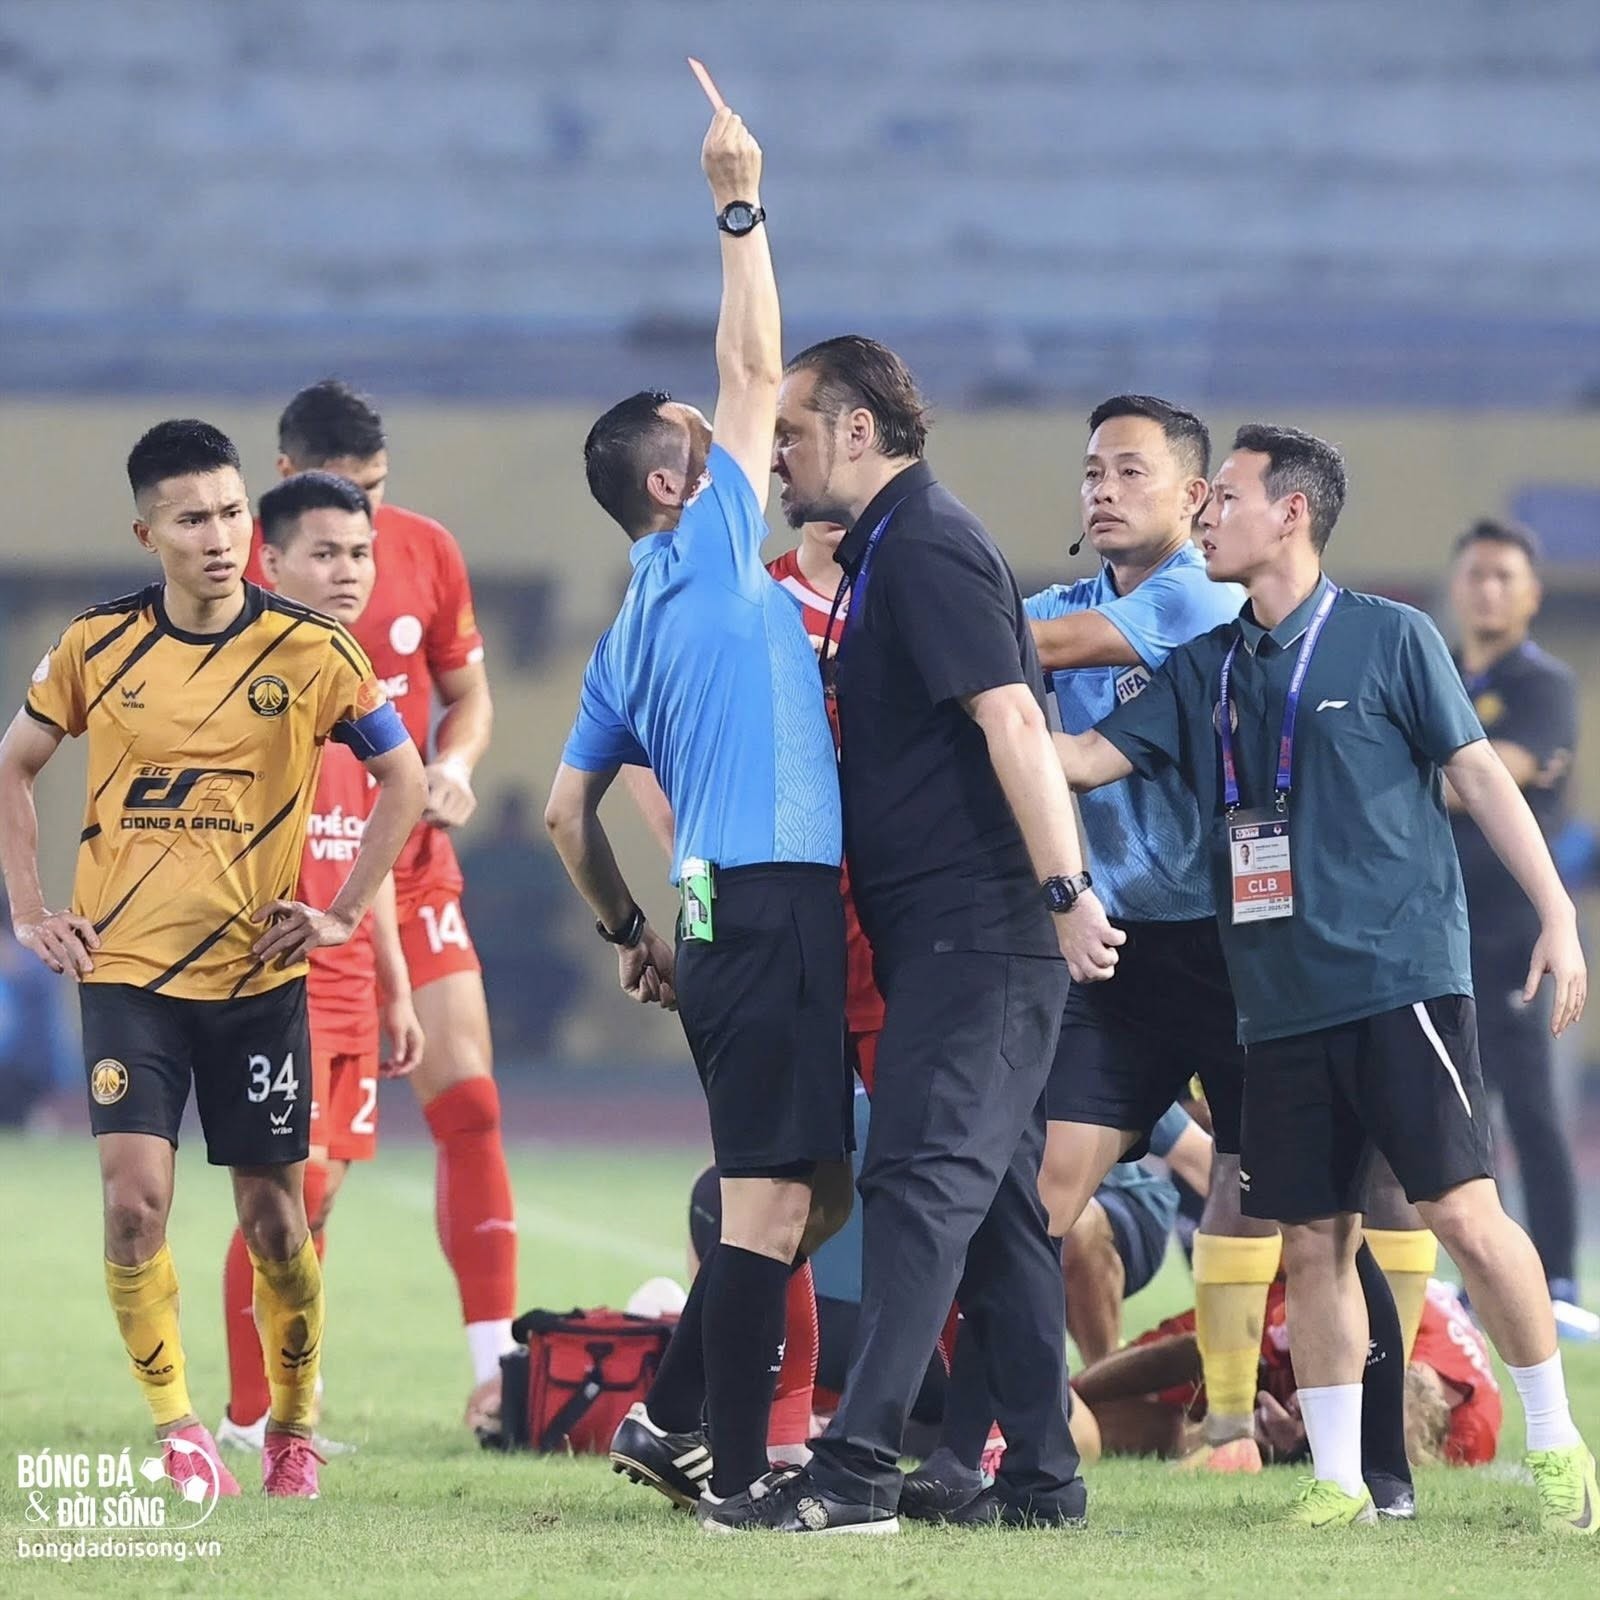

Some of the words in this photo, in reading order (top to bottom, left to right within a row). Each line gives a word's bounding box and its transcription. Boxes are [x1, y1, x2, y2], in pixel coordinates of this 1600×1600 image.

[1117, 672, 1148, 700] FIFA
[191, 817, 255, 834] GROUP
[1248, 877, 1278, 894] CLB
[418, 901, 469, 954] 14
[247, 1052, 299, 1103] 34
[350, 1077, 377, 1134] 2
